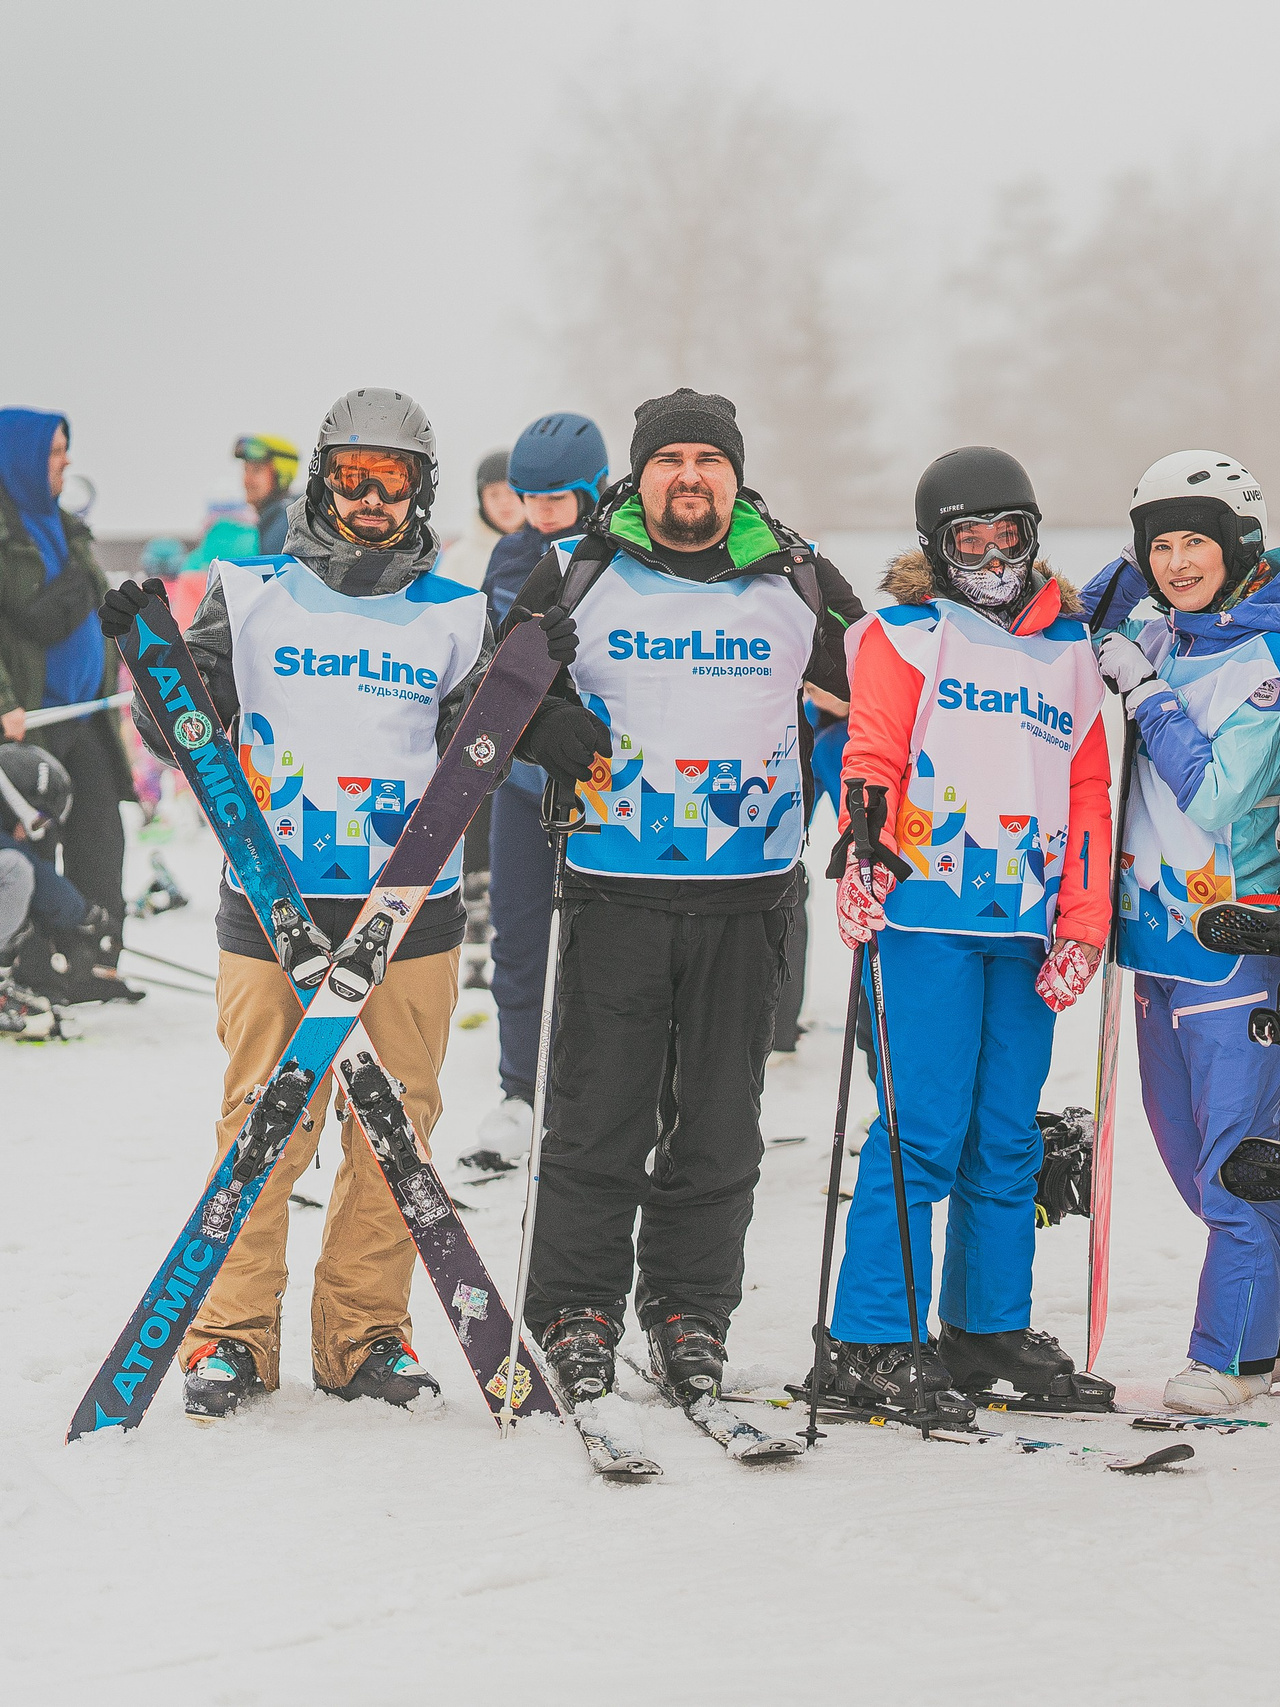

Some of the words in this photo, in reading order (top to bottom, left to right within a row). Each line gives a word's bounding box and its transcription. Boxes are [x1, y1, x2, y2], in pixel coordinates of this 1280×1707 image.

[939, 503, 965, 515] SKIFREE
[273, 646, 439, 690] StarLine
[607, 629, 771, 661] StarLine
[937, 678, 1073, 736] StarLine
[147, 667, 247, 825] ATMIC
[536, 1009, 552, 1095] SALOMON
[113, 1239, 214, 1406] ATOMIC
